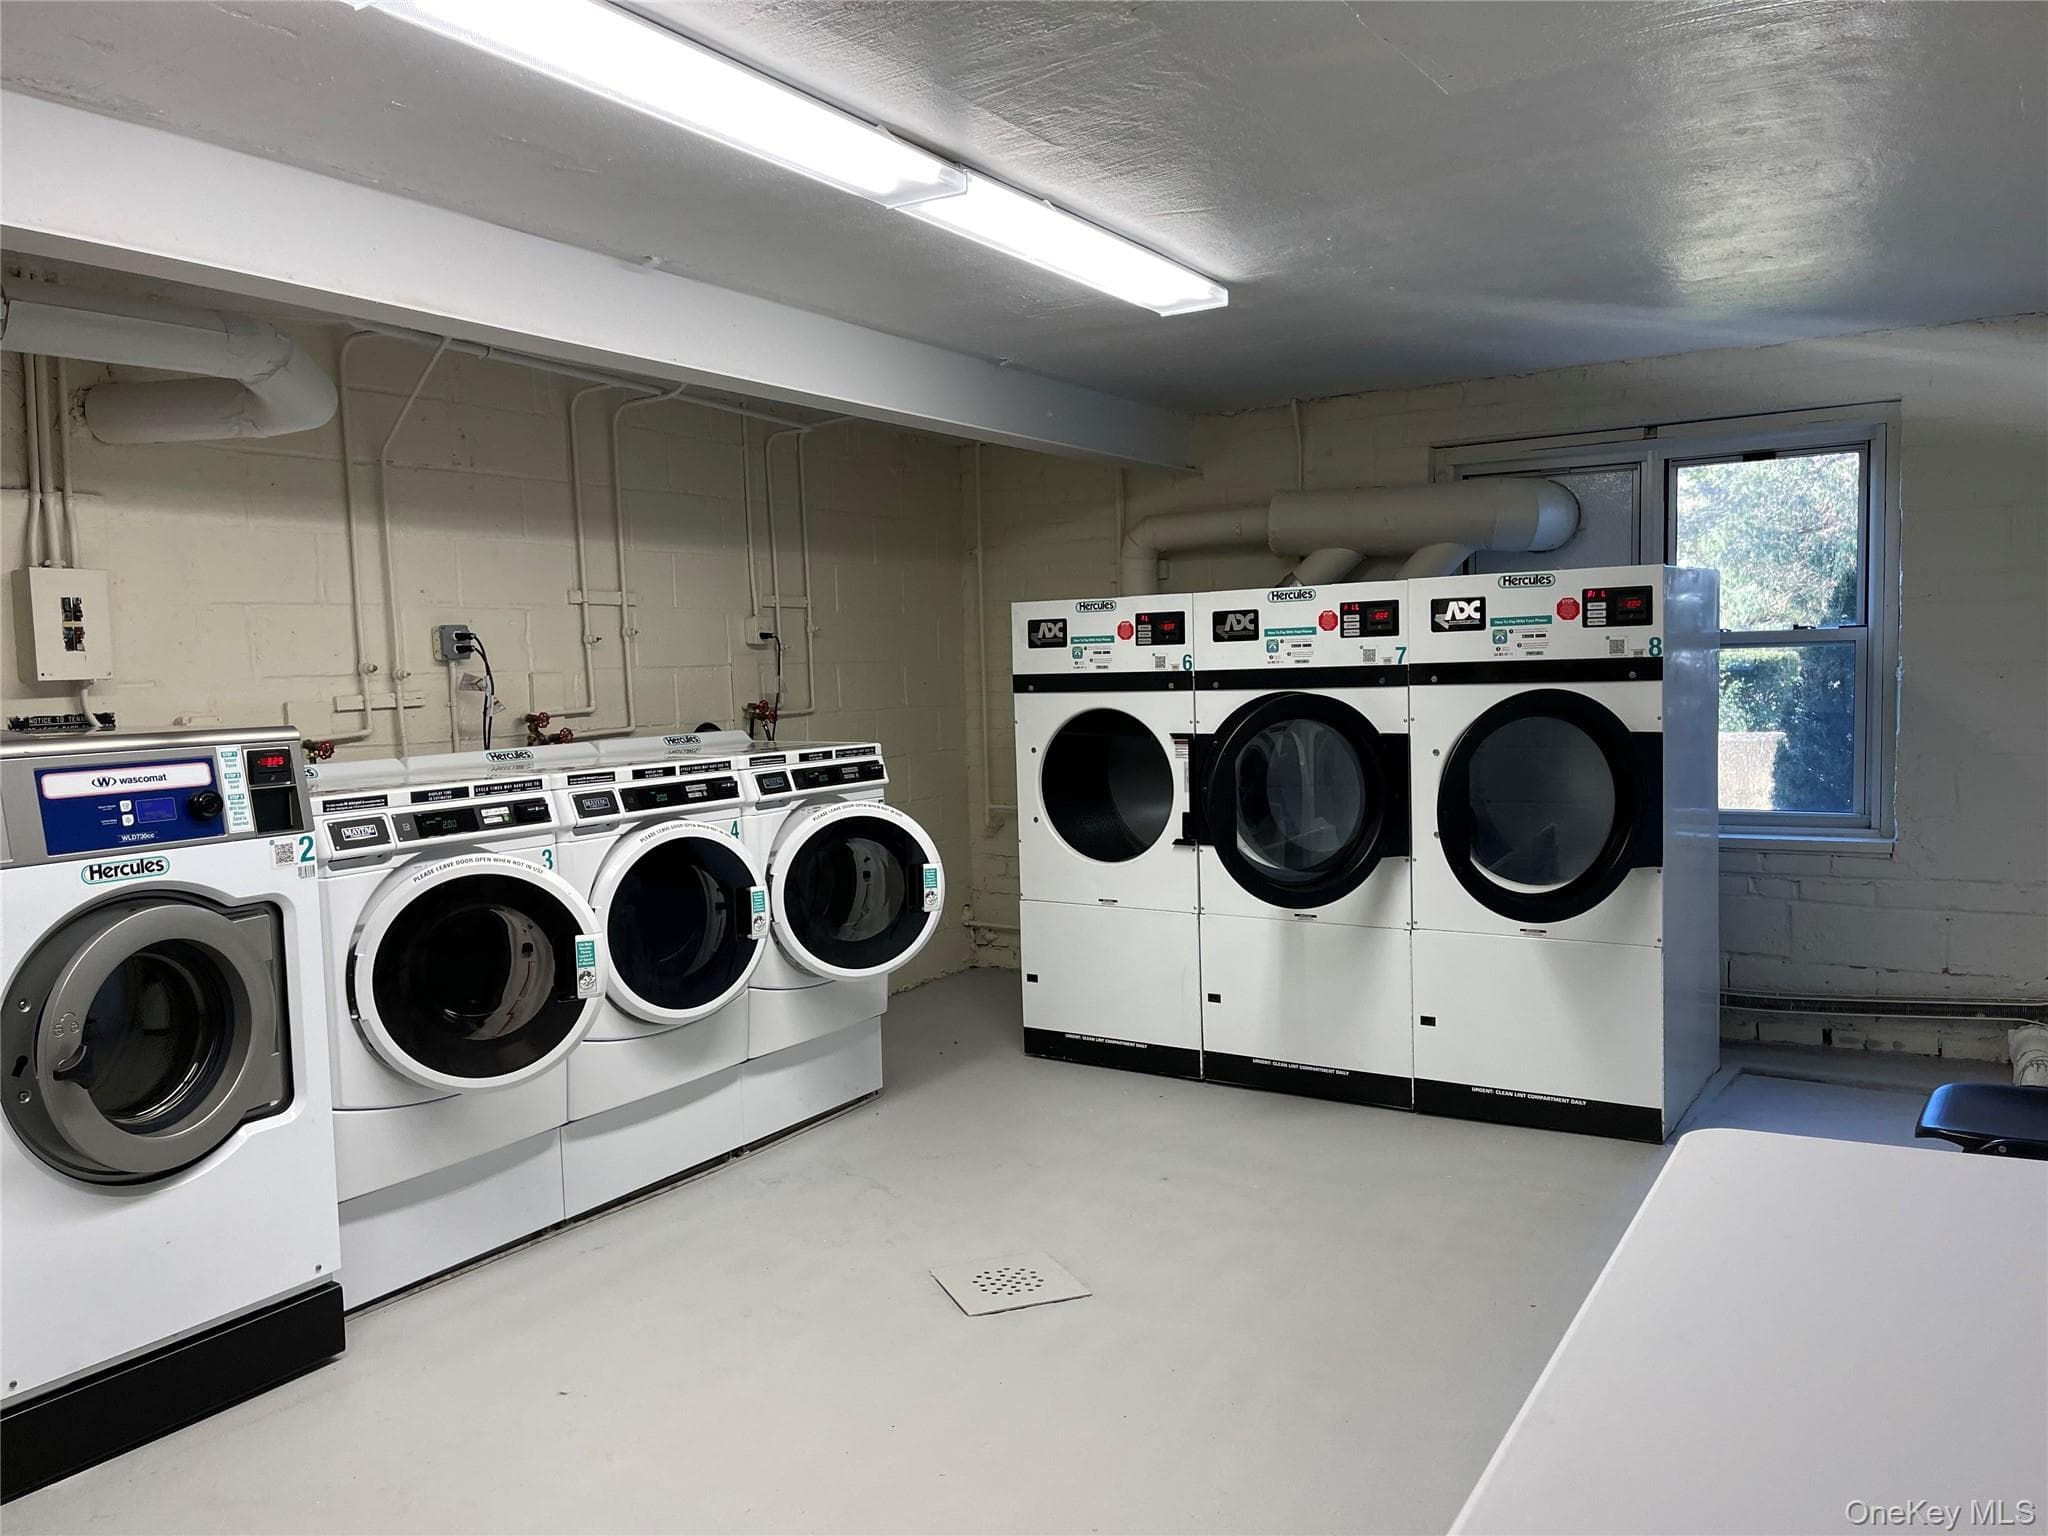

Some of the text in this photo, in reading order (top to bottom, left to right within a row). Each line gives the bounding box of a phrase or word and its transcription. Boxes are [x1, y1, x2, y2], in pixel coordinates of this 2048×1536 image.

[1503, 575, 1551, 586] Hercules
[1271, 590, 1313, 600] Hercules
[1080, 601, 1114, 611] Hercules
[1445, 600, 1480, 620] ADC
[1038, 622, 1063, 638] ADC
[1224, 613, 1254, 631] ADC
[1649, 637, 1662, 656] 8
[1183, 654, 1192, 671] 6
[1395, 647, 1407, 664] 7
[666, 736, 698, 745] Hercules
[490, 751, 530, 760] Hercules
[119, 773, 167, 785] wascomat
[812, 811, 828, 821] PLEASE
[828, 806, 841, 814] LEAVE
[343, 825, 375, 837] MAYTAG
[640, 832, 656, 843] PLEASE
[656, 825, 671, 834] LEAVE
[731, 821, 739, 839] 4
[299, 836, 315, 862] 2
[542, 849, 553, 870] 3
[89, 859, 164, 880] Hercules
[413, 868, 435, 882] PLEASE
[436, 862, 454, 872] LEAVE
[1300, 1065, 1335, 1073] COMPARTMENT
[1496, 1089, 1513, 1097] CLEAN
[1527, 1093, 1569, 1104] COMPARTMENT
